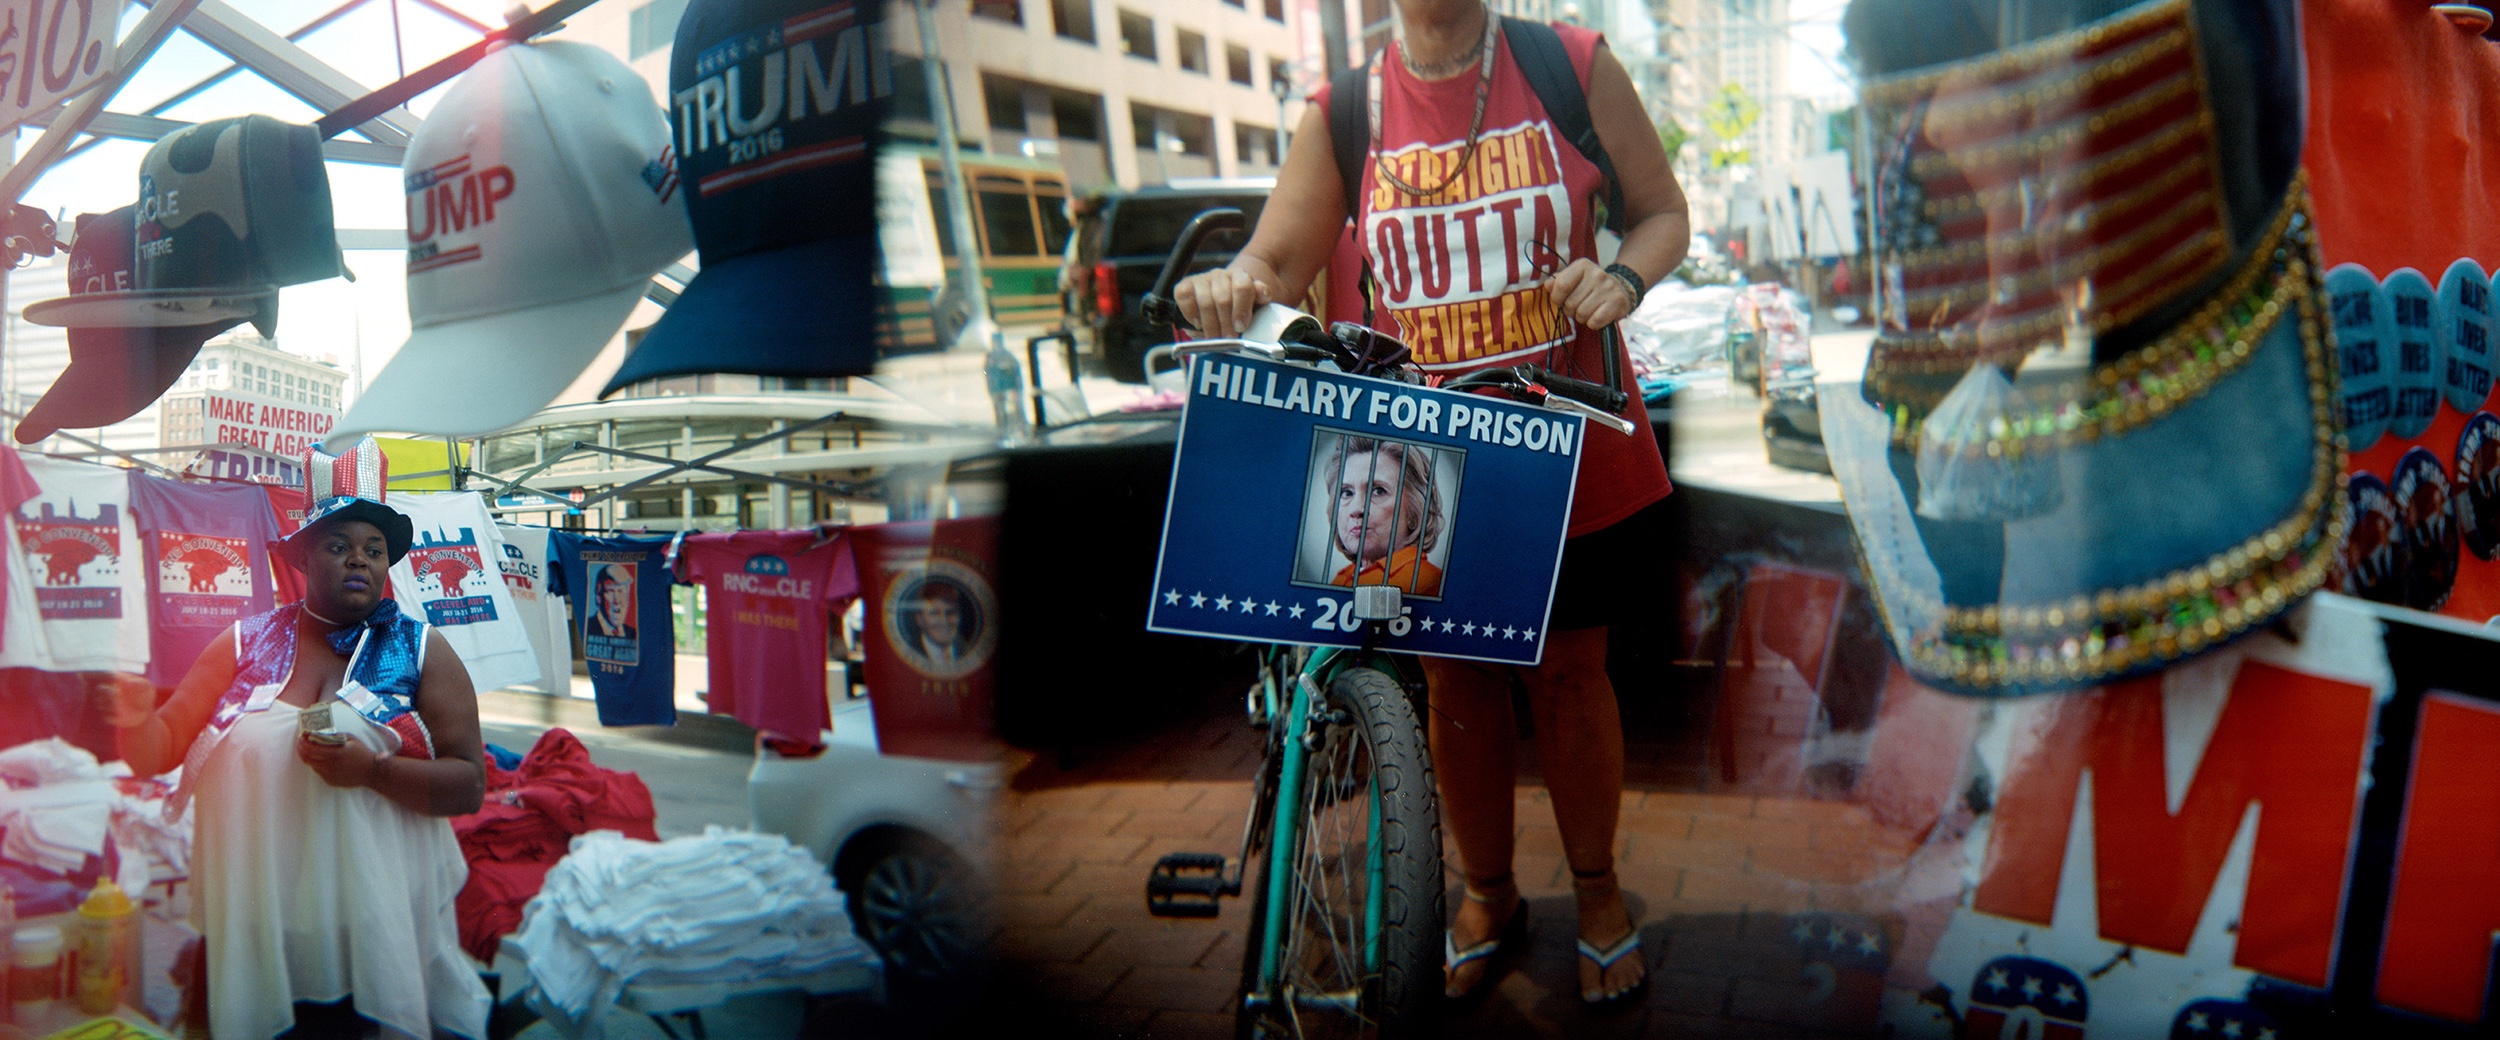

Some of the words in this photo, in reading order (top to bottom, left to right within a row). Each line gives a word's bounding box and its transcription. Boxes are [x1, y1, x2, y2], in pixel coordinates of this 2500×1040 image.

[729, 127, 784, 164] 2016
[1373, 127, 1549, 211] STRAIGHT
[145, 190, 179, 221] CLE
[140, 237, 174, 259] THERE
[1376, 194, 1560, 304] OUTTA
[209, 395, 255, 425] MAKE
[260, 405, 334, 435] AMERICA
[1199, 360, 1362, 420] HILLARY
[1369, 390, 1442, 434] FOR
[1448, 404, 1576, 456] PRISON
[217, 423, 269, 451] GREAT
[273, 433, 323, 458] AGA
[208, 449, 304, 485] TRUM
[287, 510, 305, 520] TRU
[41, 528, 120, 566] CONVENTION
[162, 547, 184, 571] RNC
[182, 538, 250, 577] CONVENTION
[416, 561, 432, 584] RNC
[428, 549, 486, 579] CONVENTION
[518, 561, 539, 579] CLE
[722, 572, 760, 594] RNC
[777, 578, 813, 600] CLE
[181, 606, 198, 615] JULY
[220, 607, 238, 616] 2016
[433, 597, 486, 610] CLEVELAND
[442, 609, 454, 617] JULY
[470, 606, 484, 614] 2016
[463, 613, 491, 624] THERE
[1311, 597, 1412, 637] 206
[586, 644, 613, 660] GREAT
[601, 662, 624, 675] 2016
